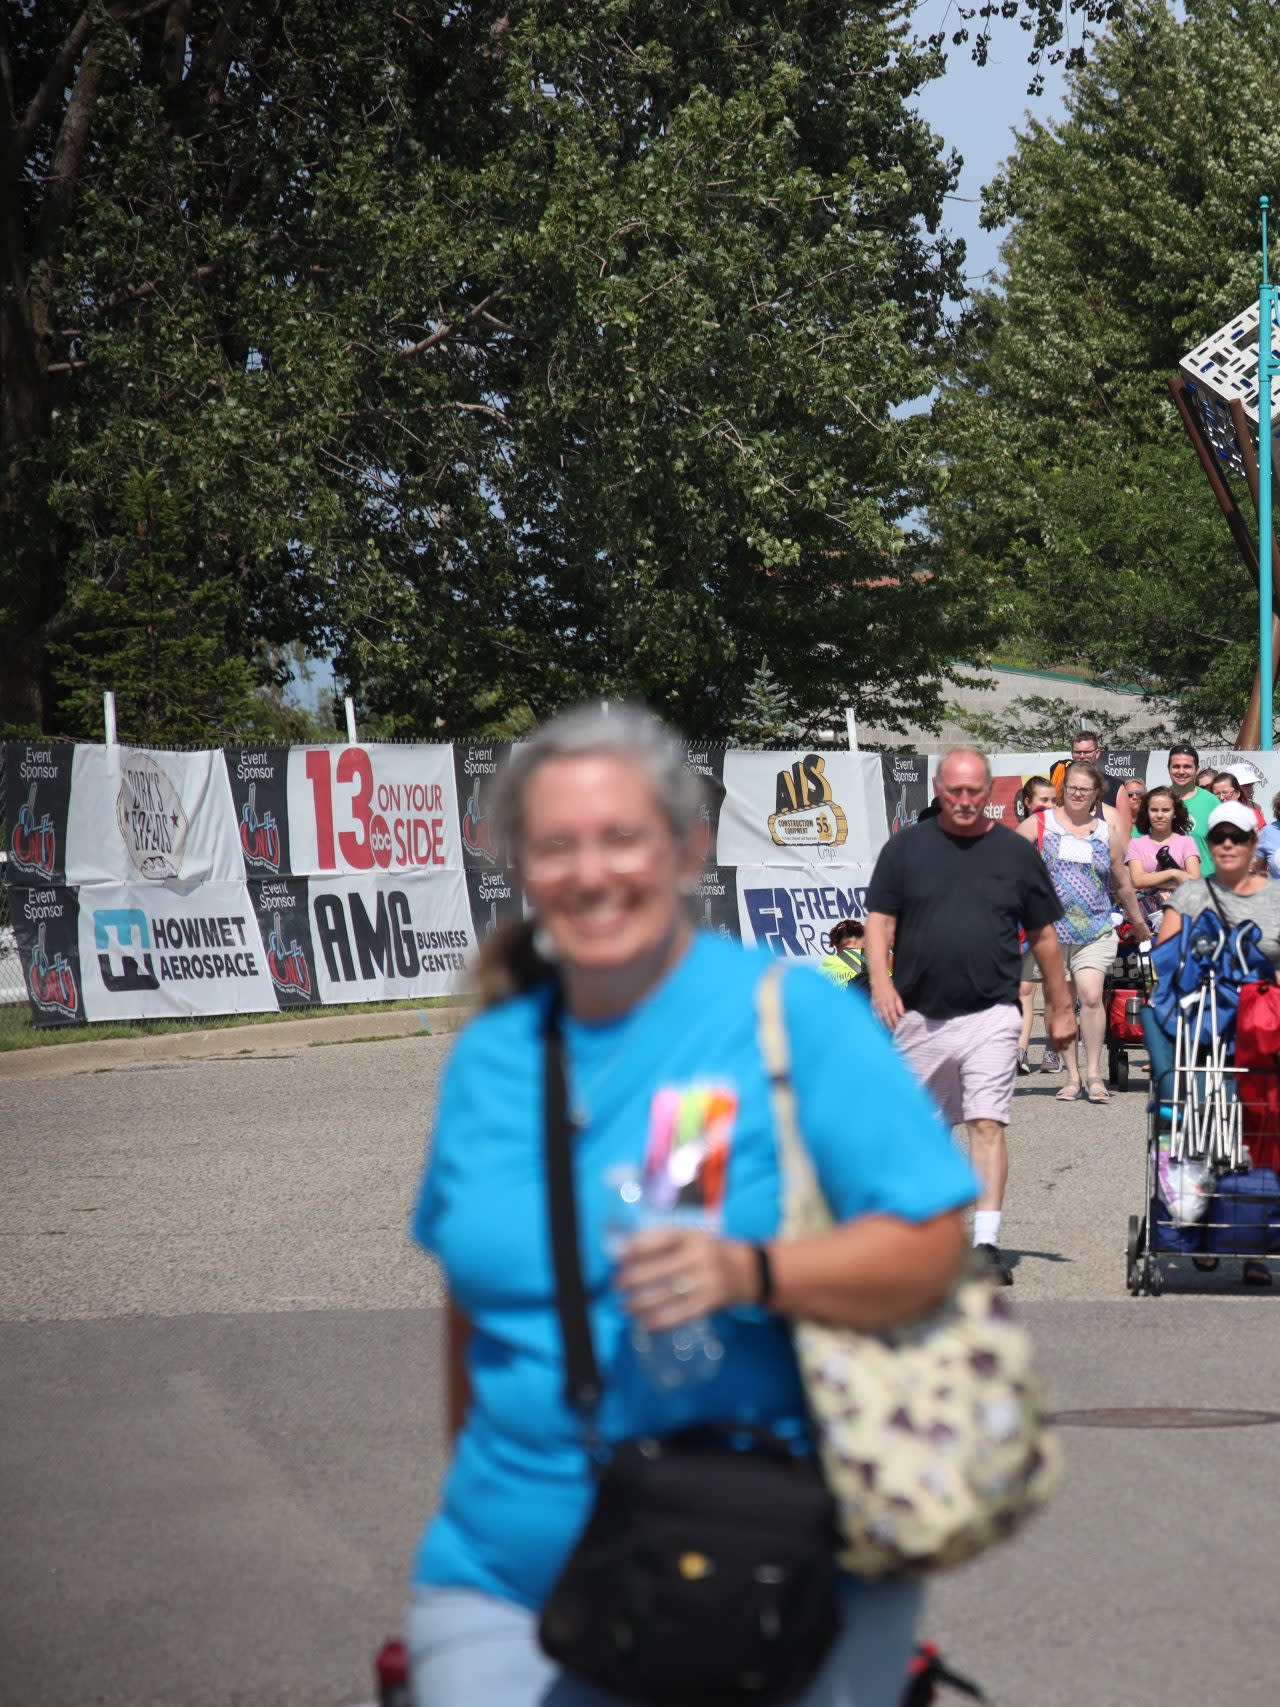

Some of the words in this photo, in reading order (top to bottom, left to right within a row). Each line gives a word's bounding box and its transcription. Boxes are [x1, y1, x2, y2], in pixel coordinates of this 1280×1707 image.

[26, 747, 51, 763] Event
[241, 751, 267, 765] Event
[468, 746, 492, 761] Event
[687, 750, 708, 764] Event
[1108, 753, 1131, 766] Event
[20, 762, 59, 781] Sponsor
[464, 760, 497, 777] Sponsor
[895, 757, 914, 770] Event
[1104, 765, 1136, 777] Sponsor
[237, 764, 275, 782] Sponsor
[892, 769, 919, 784] Sponsor
[377, 783, 401, 812] ON
[404, 783, 443, 812] YOUR
[305, 747, 375, 870] 13
[372, 826, 391, 851] abc
[393, 818, 445, 866] SIDE
[261, 880, 289, 895] Event
[481, 872, 505, 886] Event
[28, 888, 57, 904] Event
[478, 885, 512, 902] Sponsor
[260, 894, 296, 912] Sponsor
[24, 904, 65, 922] Sponsor
[152, 916, 247, 949] HOWMET
[313, 890, 421, 983] AMG
[416, 930, 469, 950] BUSINESS
[160, 952, 259, 980] AEROSPACE
[421, 953, 467, 973] CENTER
